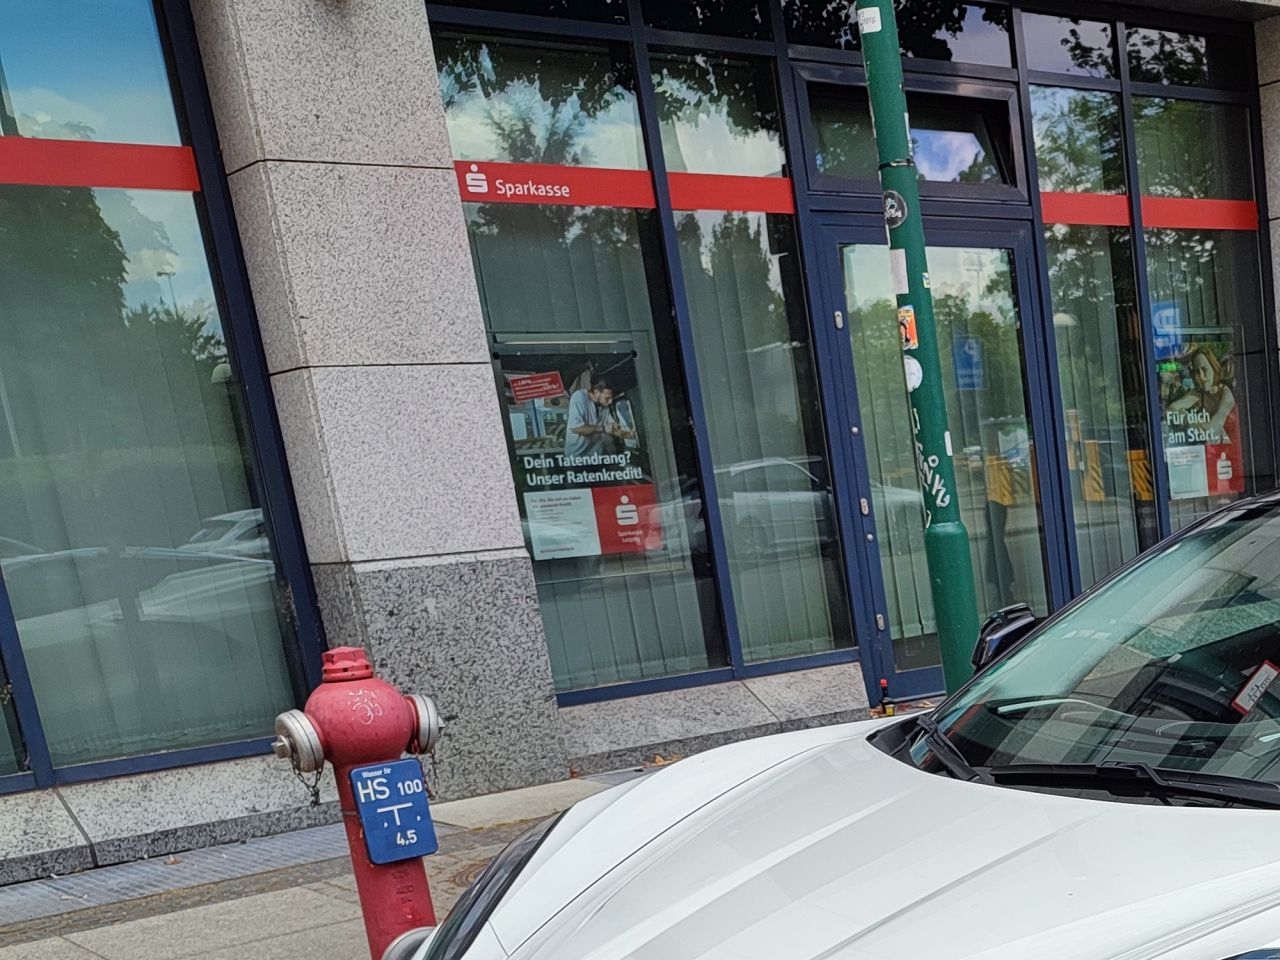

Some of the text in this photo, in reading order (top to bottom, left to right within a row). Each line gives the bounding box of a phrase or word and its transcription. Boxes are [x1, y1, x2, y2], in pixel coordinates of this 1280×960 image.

[495, 179, 570, 198] Sparkasse
[1166, 408, 1210, 425] Für dich
[1168, 430, 1186, 444] am
[523, 451, 631, 469] Dein Tatendrang?
[526, 467, 643, 486] Unser Ratenkredit!
[357, 778, 423, 803] HS 100
